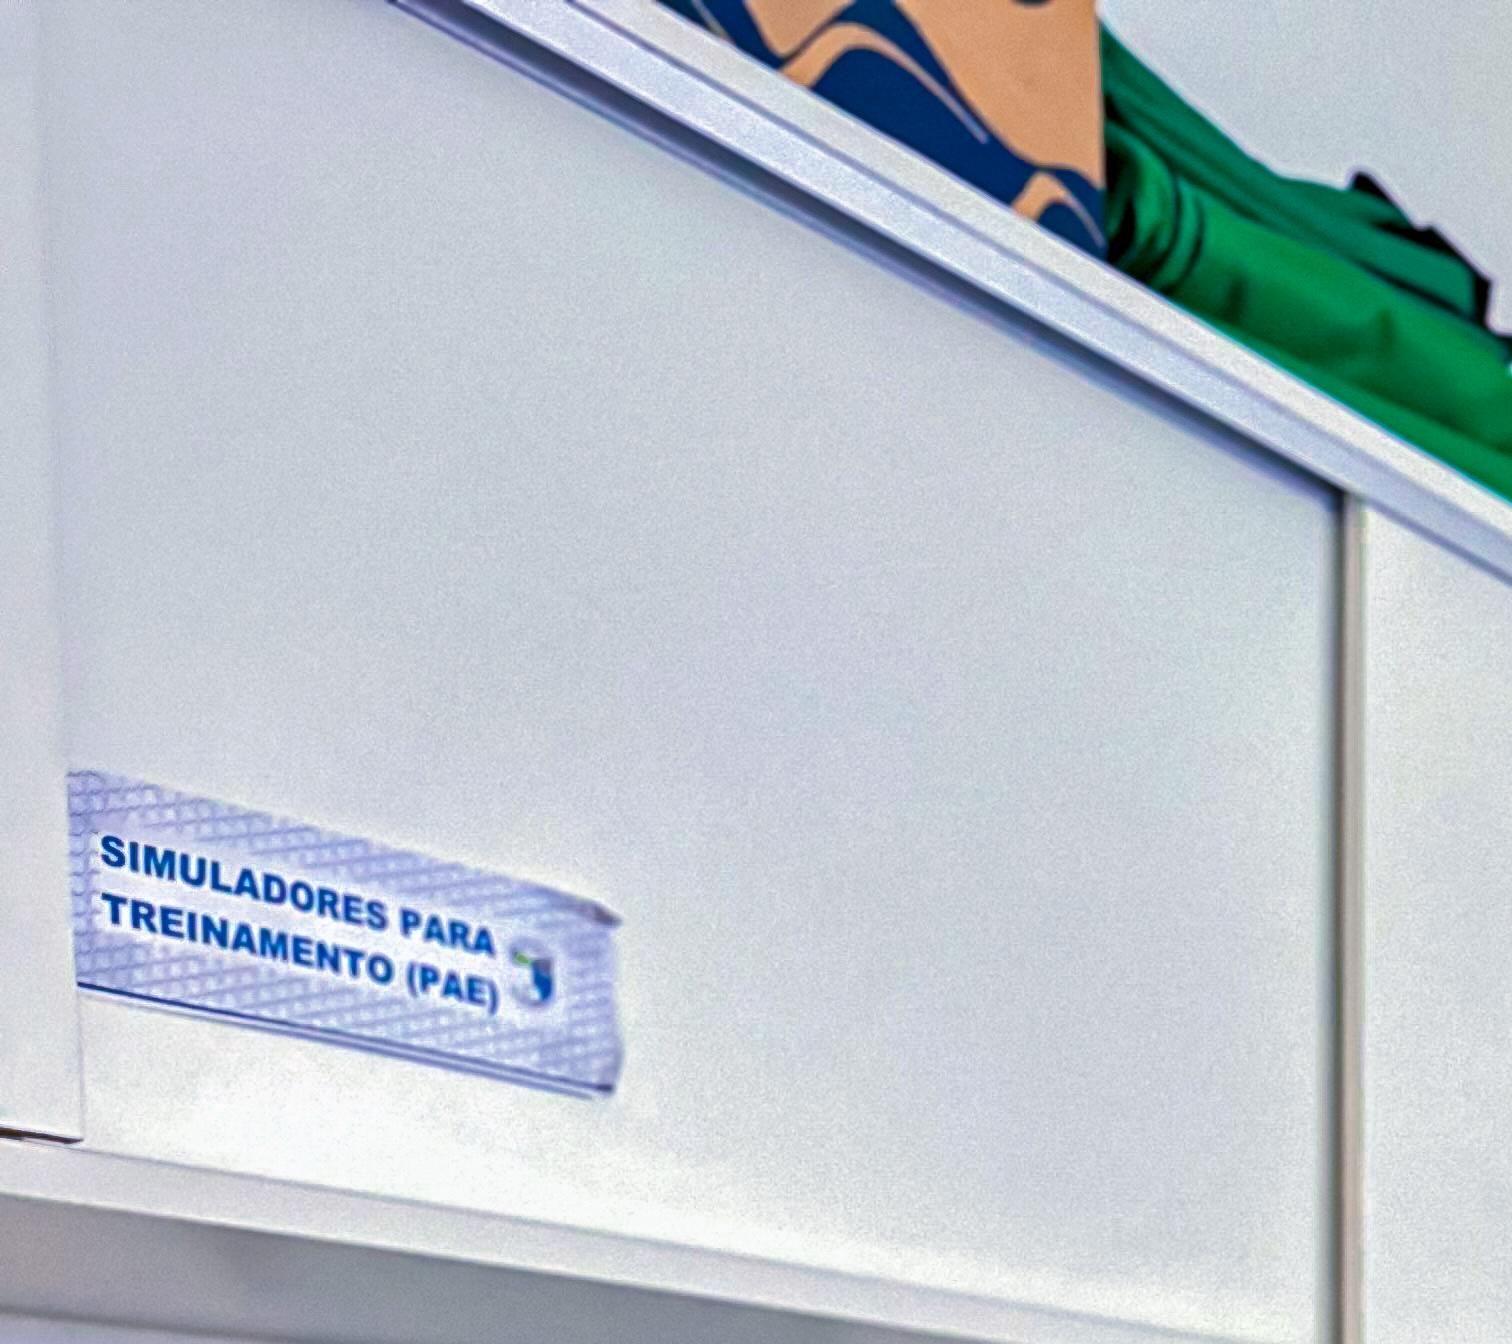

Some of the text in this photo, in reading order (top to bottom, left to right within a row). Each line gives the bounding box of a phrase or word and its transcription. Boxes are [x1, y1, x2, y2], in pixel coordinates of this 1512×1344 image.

[101, 835, 496, 957] SIMULADORES PARA
[101, 893, 499, 1015] TREINAMENTO (PAE)
